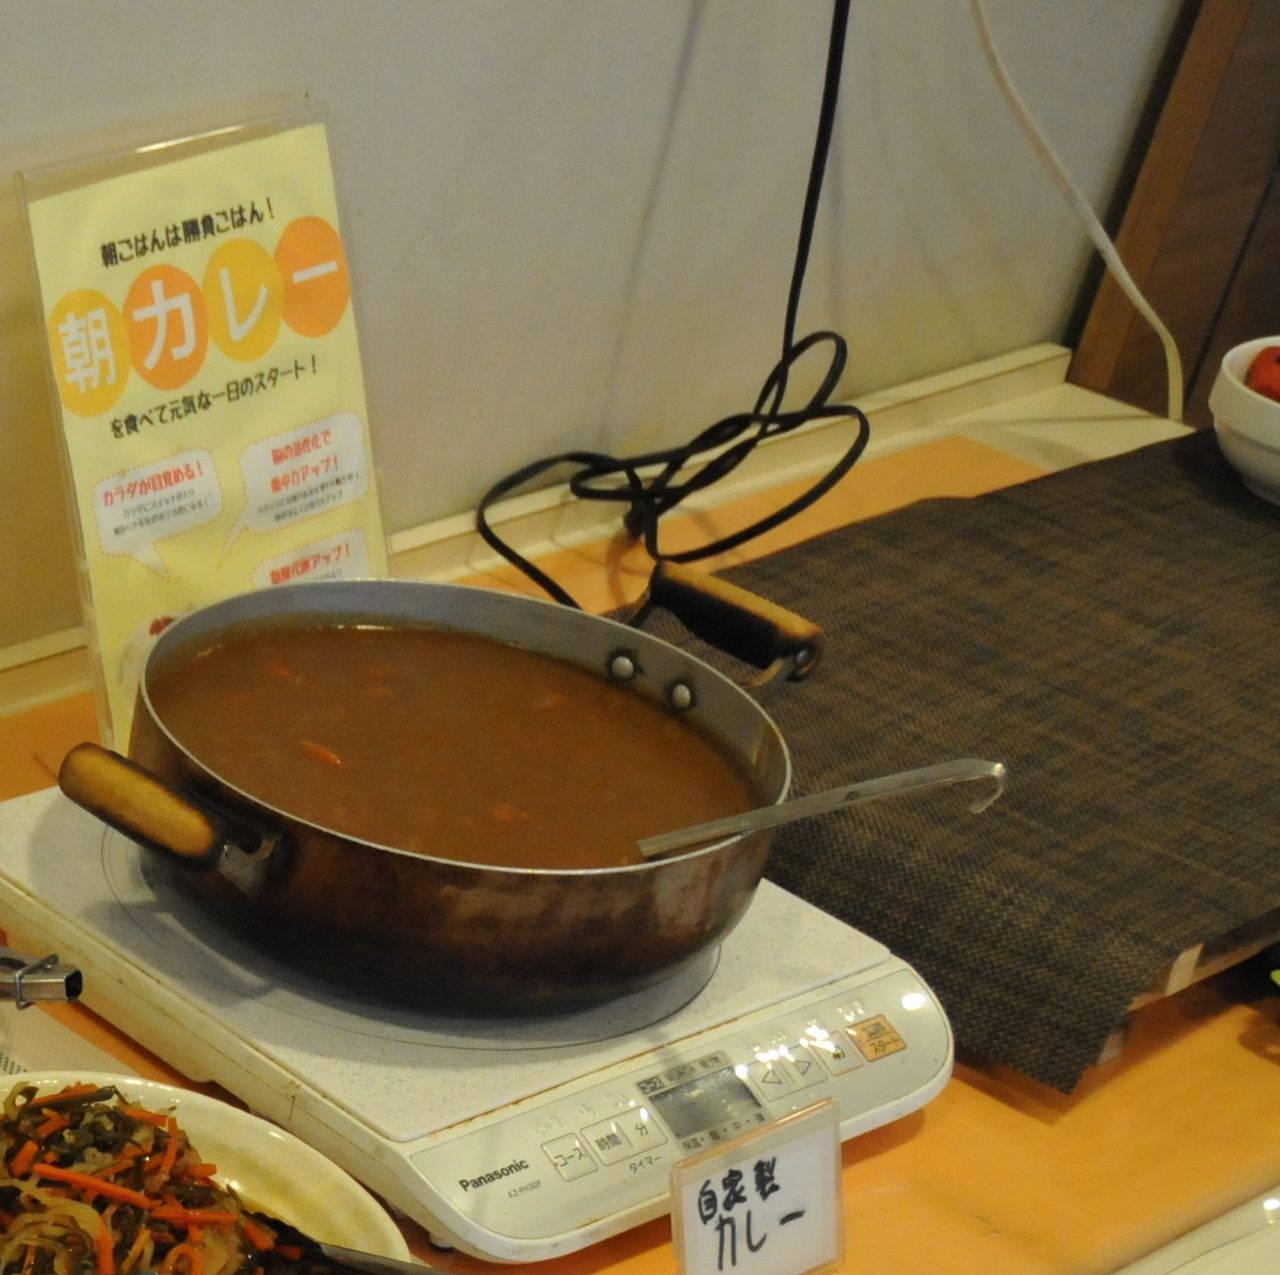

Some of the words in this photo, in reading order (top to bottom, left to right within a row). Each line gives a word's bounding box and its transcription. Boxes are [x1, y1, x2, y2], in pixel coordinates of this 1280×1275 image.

[57, 260, 339, 396] 朝カレー
[634, 1122, 650, 1138] 分
[457, 1157, 530, 1193] Panasonic
[554, 1146, 590, 1169] コース
[714, 1208, 807, 1272] カレー
